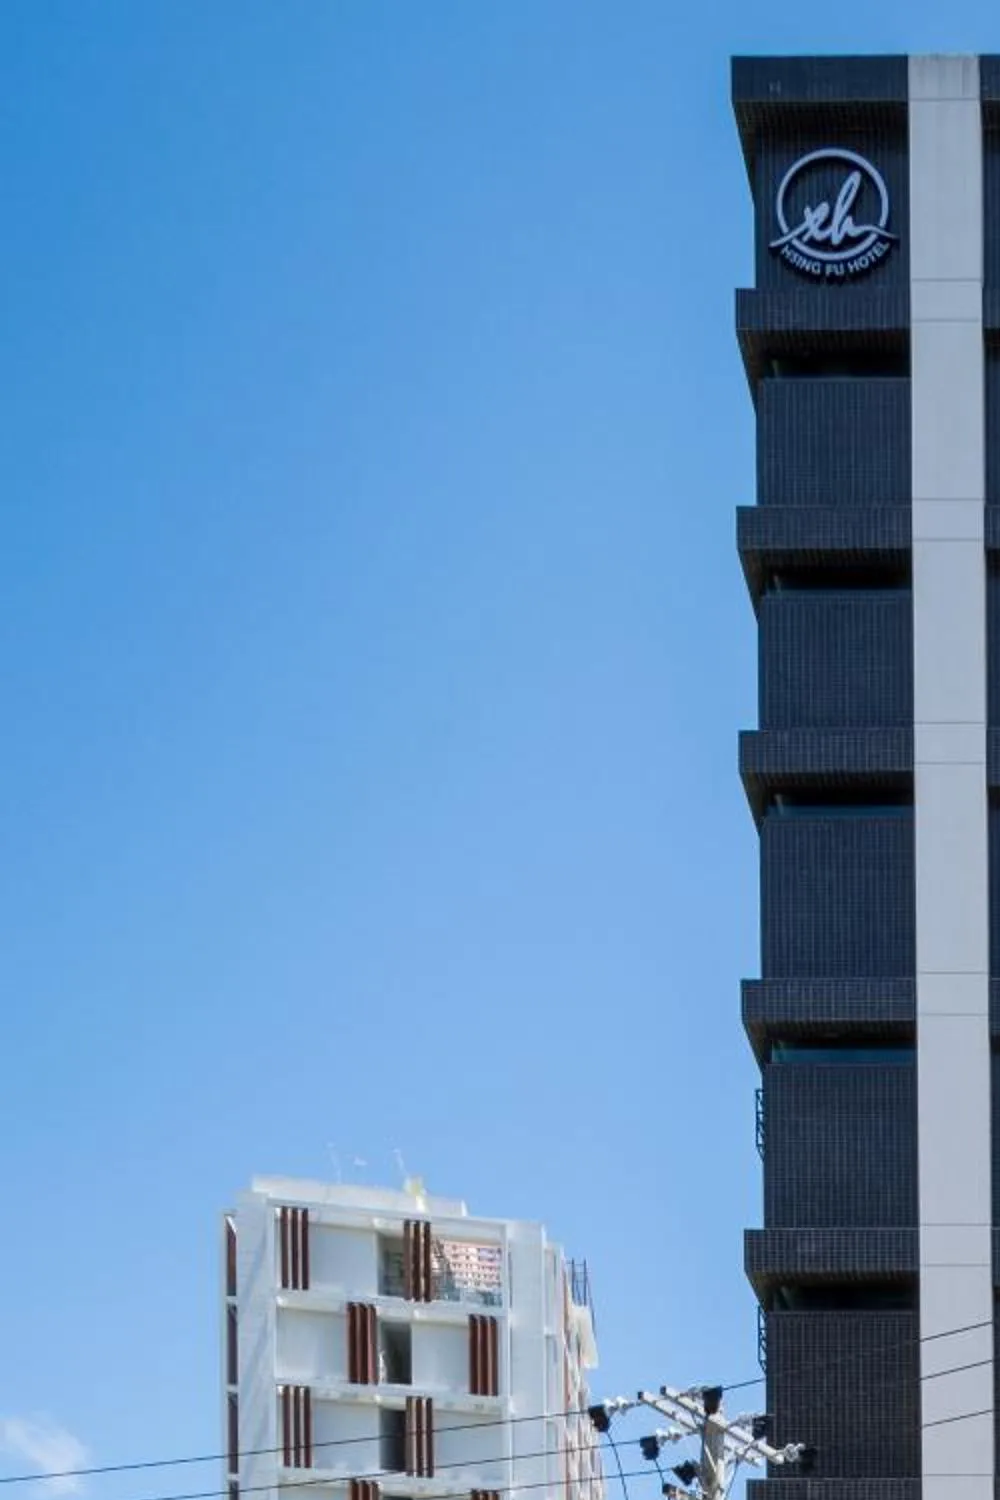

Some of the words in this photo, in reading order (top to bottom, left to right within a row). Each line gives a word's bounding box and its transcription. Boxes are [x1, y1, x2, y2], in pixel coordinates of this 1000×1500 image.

[780, 244, 821, 275] HSING
[825, 263, 844, 276] FU
[847, 241, 890, 273] HOTEL
